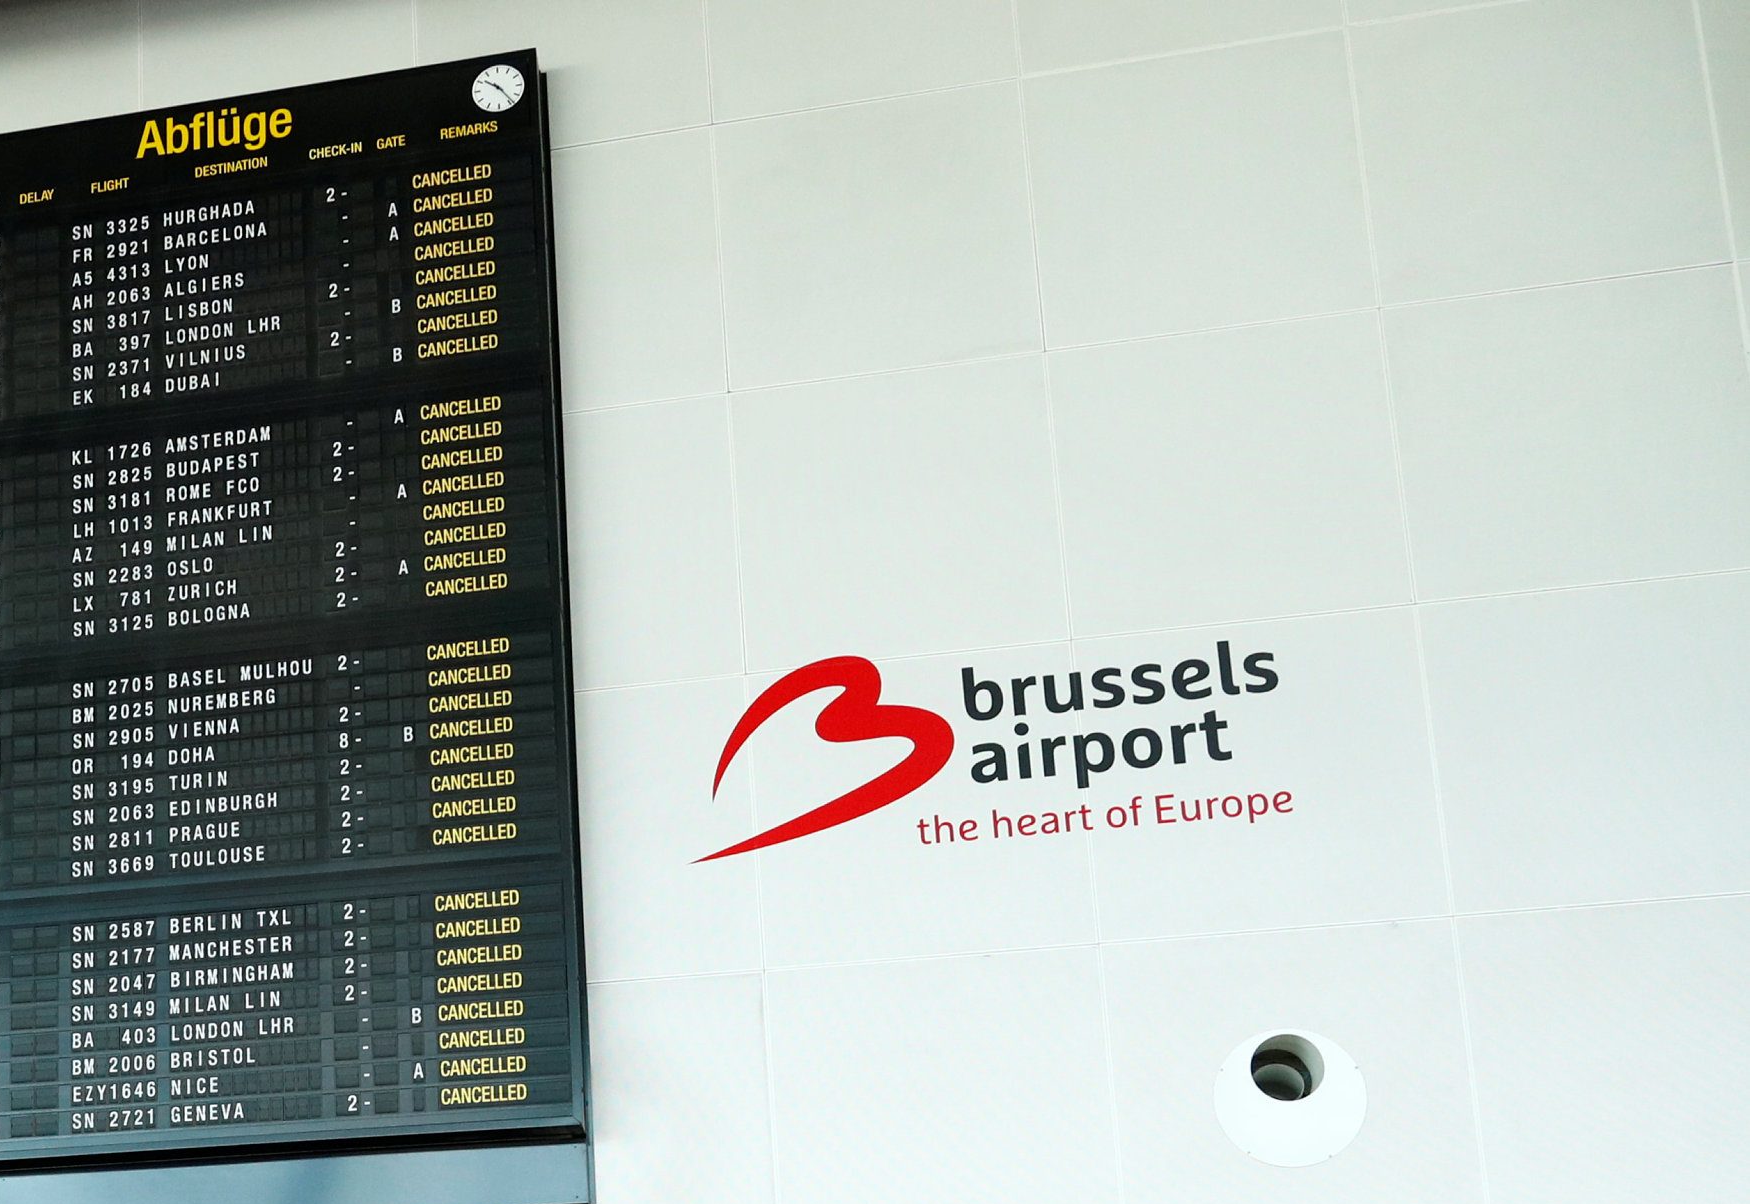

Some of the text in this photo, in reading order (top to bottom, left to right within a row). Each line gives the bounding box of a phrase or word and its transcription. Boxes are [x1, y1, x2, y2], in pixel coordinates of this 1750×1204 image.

[135, 107, 293, 159] Abflüge
[19, 188, 55, 205] DELAY
[90, 177, 130, 194] FLIGHT
[194, 156, 268, 179] DESTINATION
[308, 141, 363, 160] CHECK-IN
[376, 134, 406, 150] GATE
[440, 120, 498, 140] REMARKS
[412, 163, 492, 189] CANCELLED
[72, 200, 255, 241] SN 3325 HURGHADA
[72, 221, 267, 264] FR 2921 BARCELONA
[164, 253, 209, 274] LYON
[163, 272, 244, 298] ALGIERS
[165, 297, 233, 322] LISBON
[165, 344, 246, 369] VILNIUS
[165, 371, 219, 394] DUBAI
[165, 425, 271, 454] AMSTERDAM
[166, 452, 260, 478] BUDAPEST
[167, 500, 272, 528] FRANKFURT
[167, 556, 213, 577] OSLO
[167, 579, 237, 602] ZURICH
[425, 573, 508, 597] CANCELLED
[168, 658, 312, 689] BASEL MULHOU
[960, 640, 1280, 722] brussels
[168, 688, 276, 715] NUREMBERG
[168, 717, 240, 740] VIENNA
[168, 745, 215, 766] DOHA
[970, 709, 1233, 789] airport
[168, 770, 227, 791] TURIN
[169, 791, 277, 817] EDINBURGH
[916, 788, 1294, 845] the heart of Europe
[169, 821, 240, 843] PRAGUE
[169, 845, 265, 869] TOULOUSE
[434, 889, 520, 912] CANCELLED
[169, 909, 292, 934] BERLIN TXL
[169, 935, 292, 961] MANCHESTER
[170, 962, 294, 988] BIRMINGHAM
[169, 990, 280, 1015] MILAN LIN
[171, 1016, 294, 1042] LONDON LHR
[170, 1047, 256, 1069] BRISTOL
[72, 1076, 219, 1103] EZY1646 NICE
[440, 1083, 527, 1105] CANCELLED
[109, 1102, 244, 1128] 2721 GENEVA
